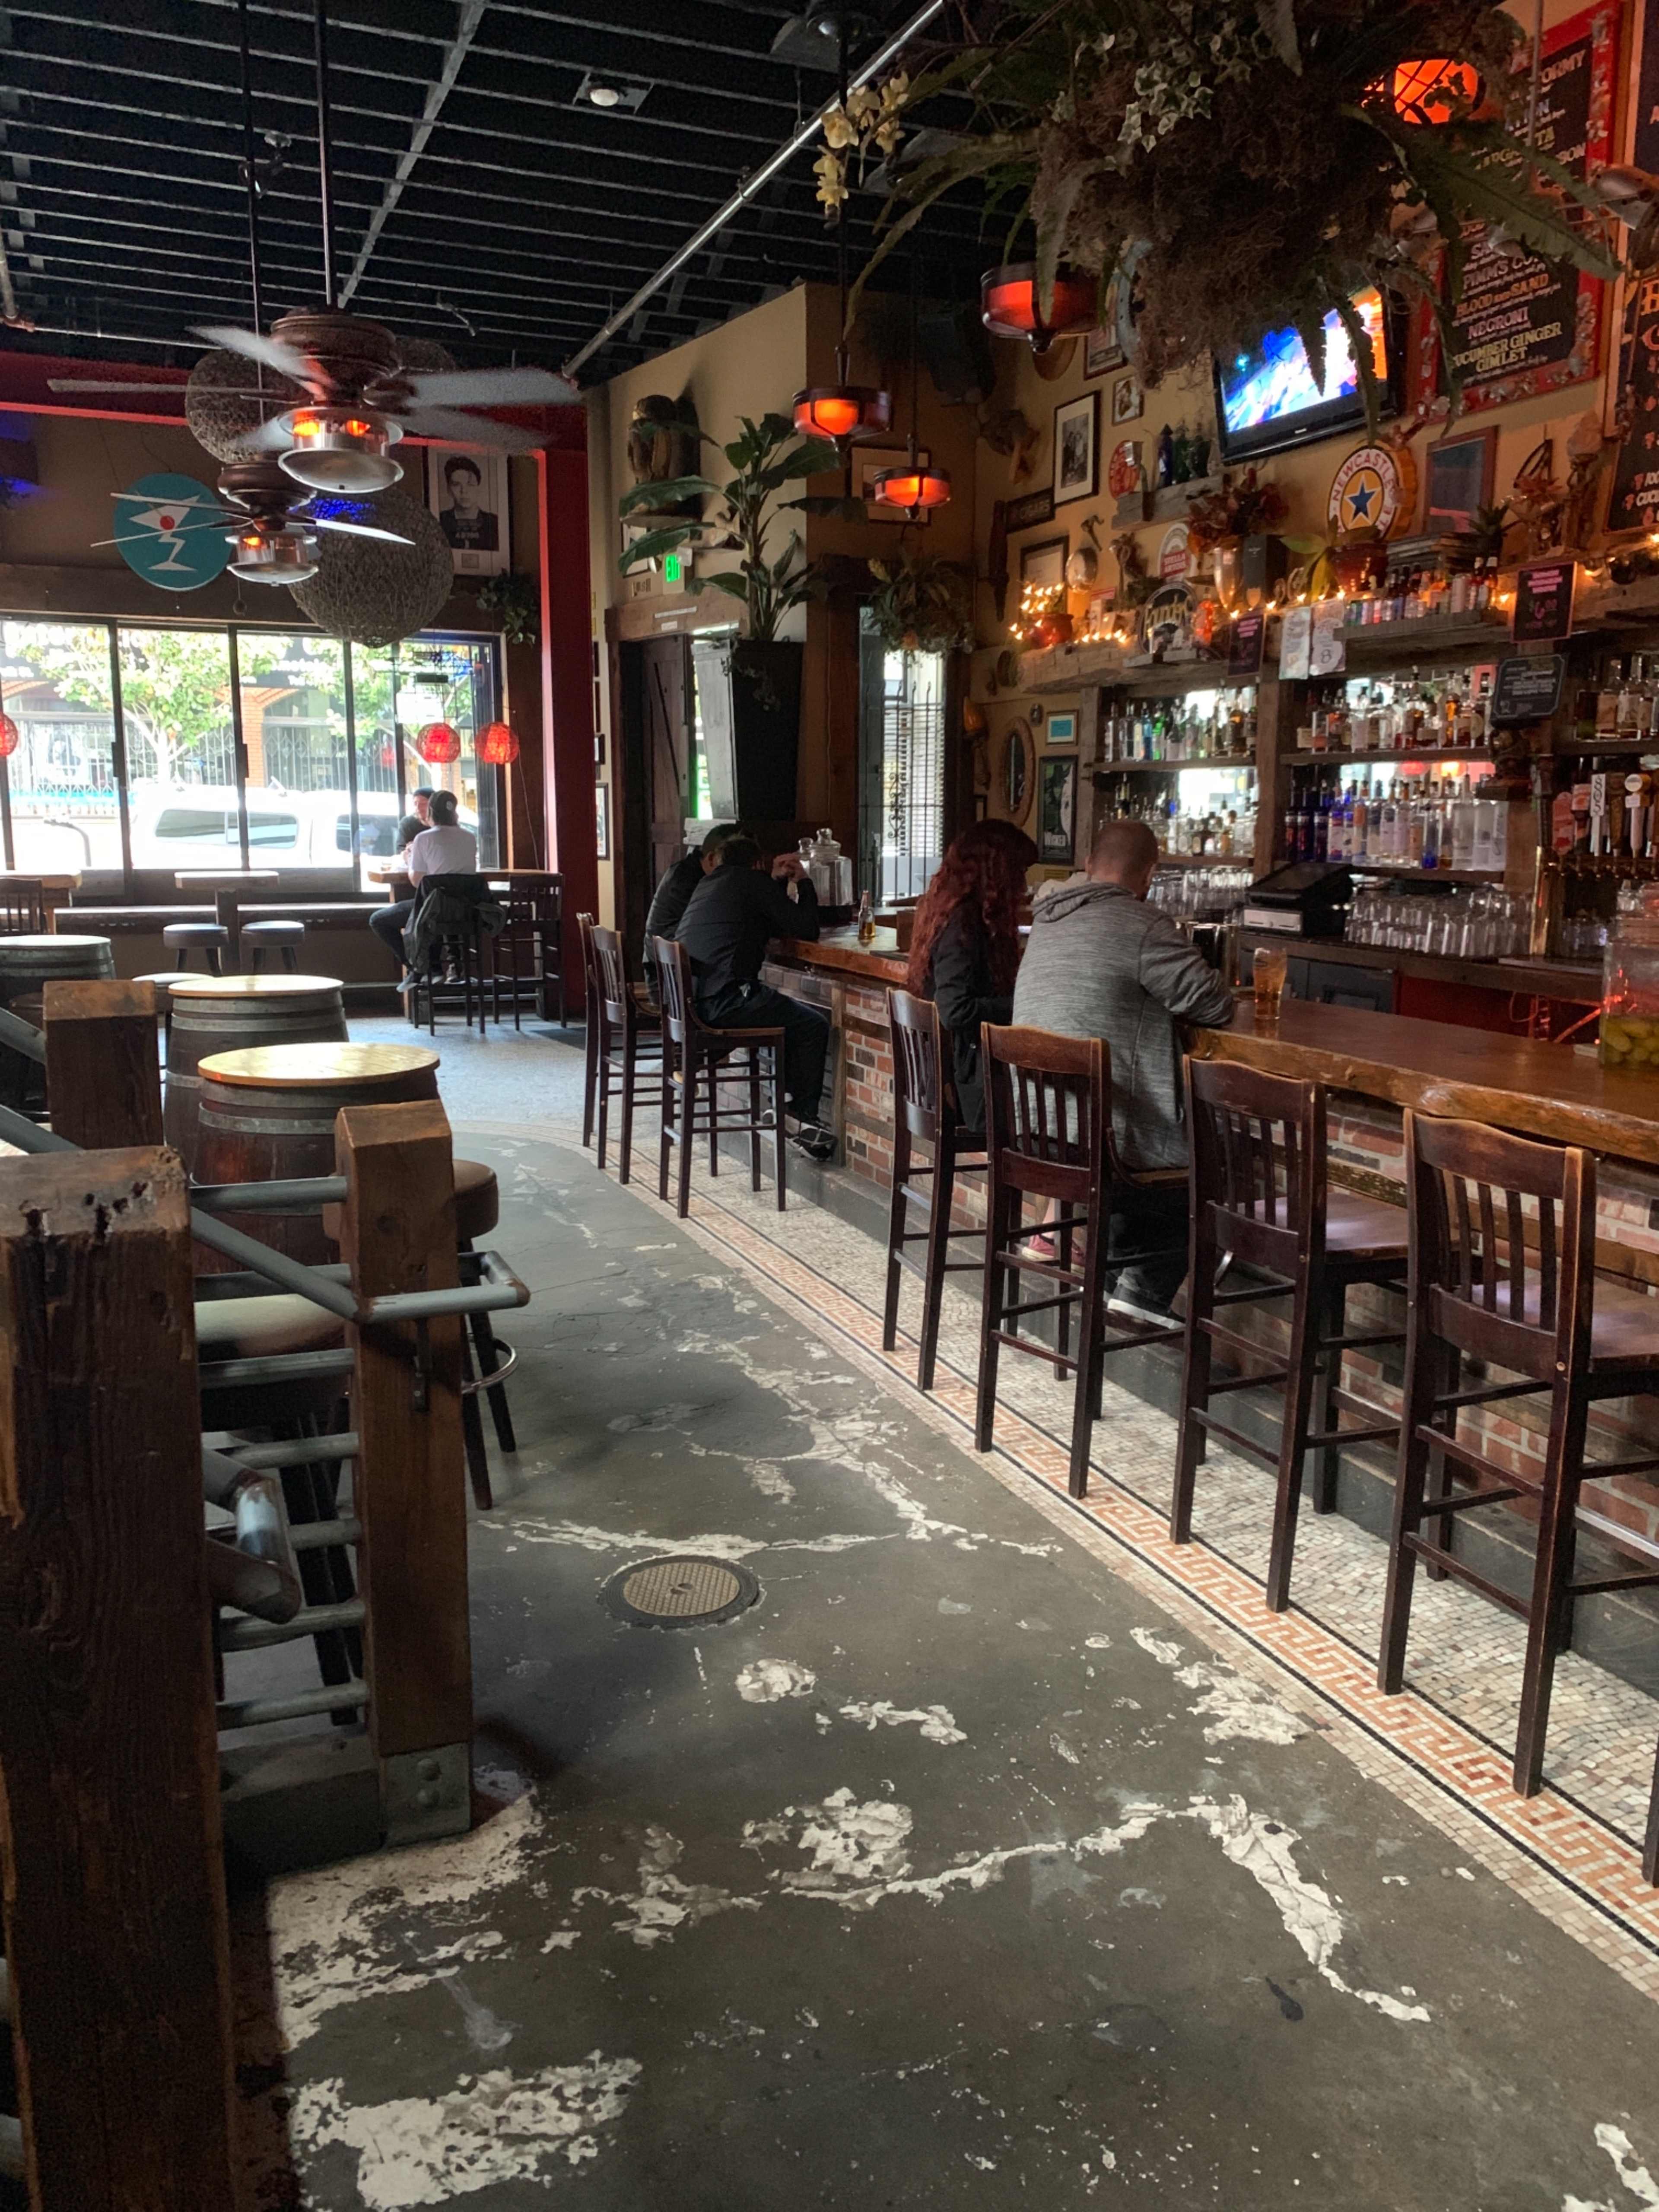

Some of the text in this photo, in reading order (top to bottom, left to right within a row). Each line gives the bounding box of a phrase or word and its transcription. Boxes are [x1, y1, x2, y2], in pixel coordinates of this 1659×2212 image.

[1541, 50, 1586, 83] ORMY
[1511, 273, 1548, 294] SAND
[1468, 307, 1528, 339] NEGRONI
[1453, 339, 1509, 366] UCUMBER
[1510, 322, 1563, 349] GINGER
[1476, 346, 1528, 372] GIMLET
[1332, 452, 1394, 500] NEWCASTLE
